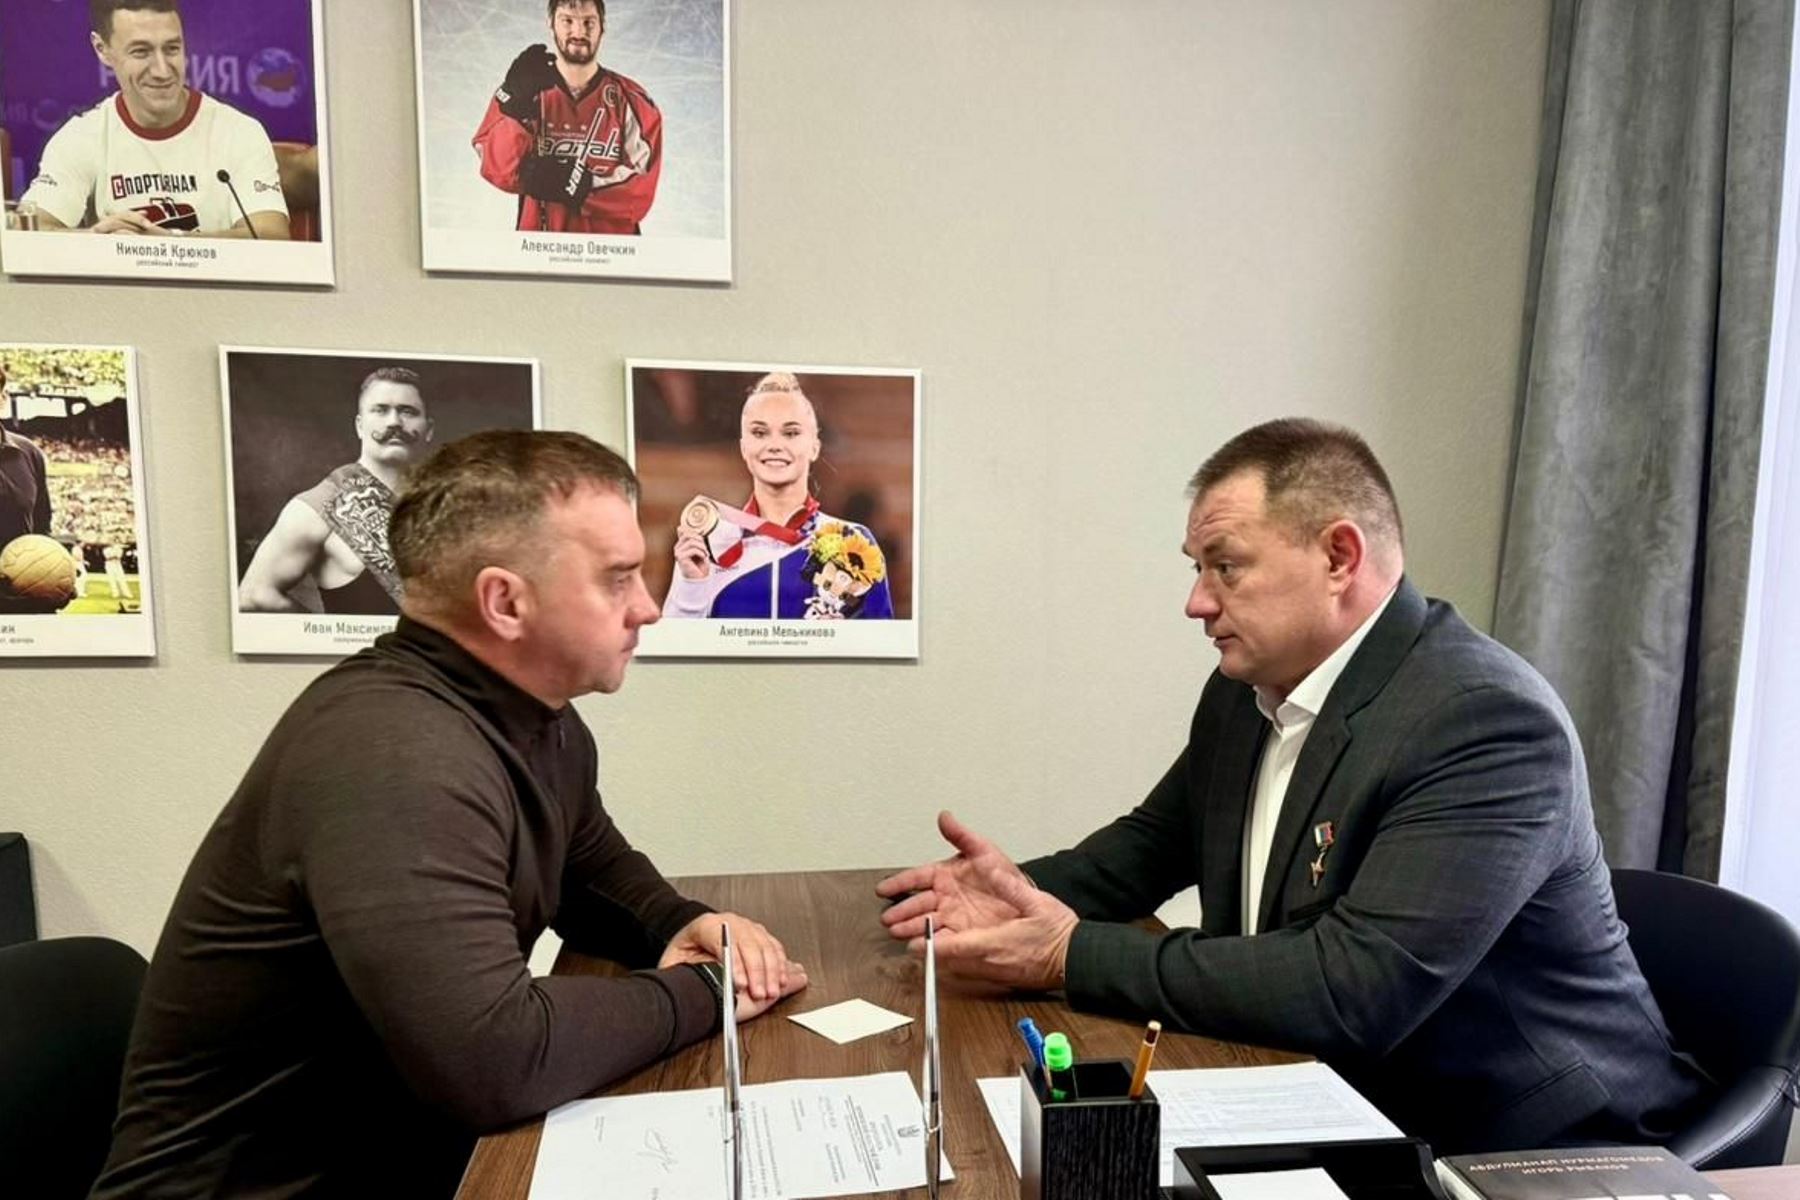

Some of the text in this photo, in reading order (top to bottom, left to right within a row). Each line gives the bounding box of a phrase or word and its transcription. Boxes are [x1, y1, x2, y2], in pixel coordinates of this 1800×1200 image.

[116, 242, 217, 260] Николай Крюков
[521, 239, 635, 256] Александр Овечкин
[303, 622, 332, 635] Иван
[720, 625, 836, 638] Ангелина Мельникова
